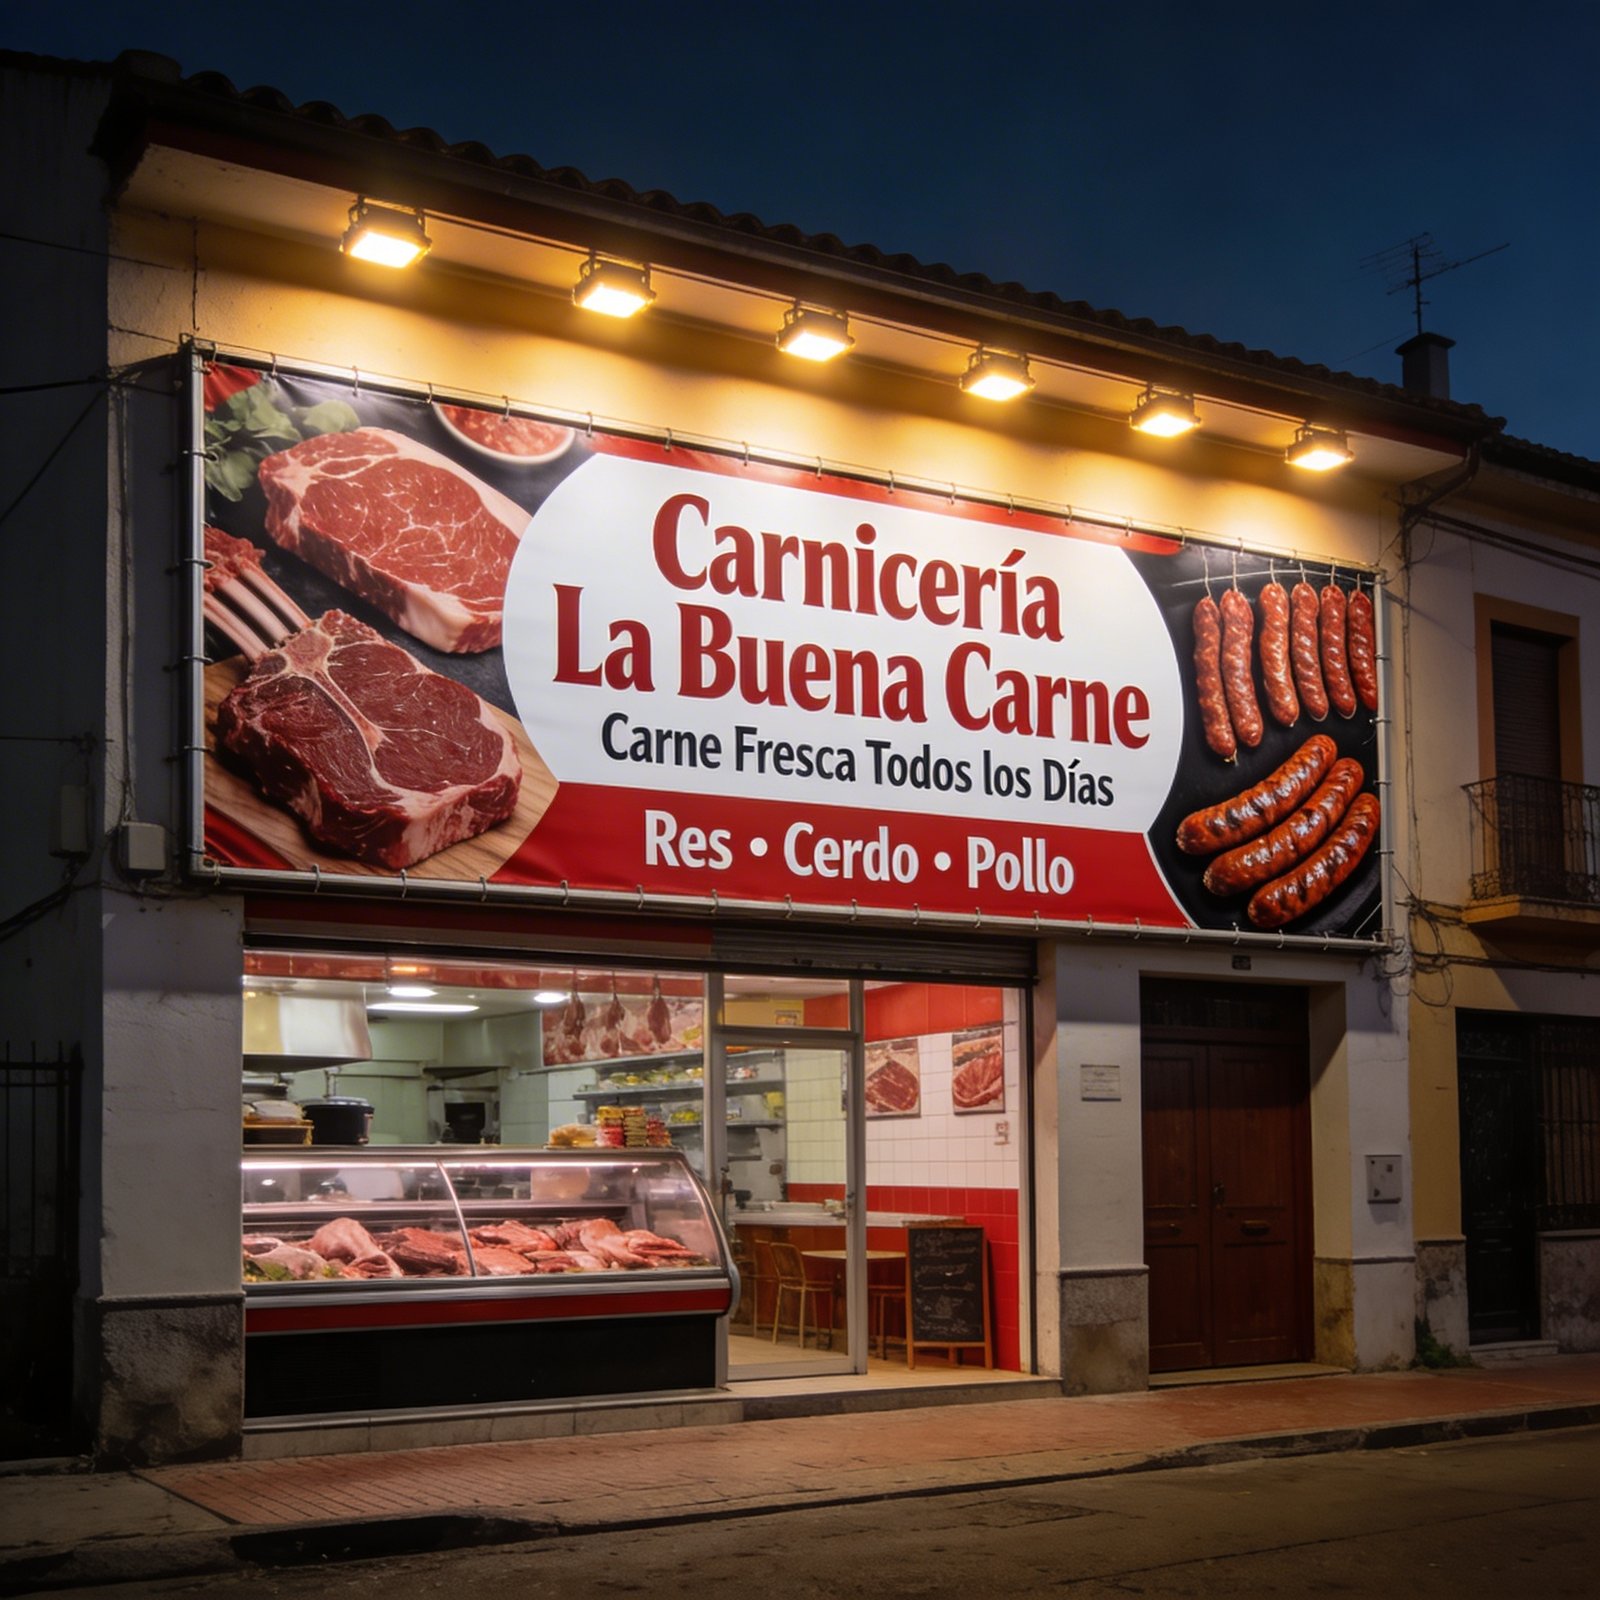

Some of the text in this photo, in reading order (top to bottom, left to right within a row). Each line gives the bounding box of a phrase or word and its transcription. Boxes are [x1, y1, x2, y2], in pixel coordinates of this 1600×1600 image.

[652, 493, 1063, 642] Carnicería
[553, 583, 1151, 749] La Buena Carne
[601, 711, 1114, 807] Carne Fresca Todos los Días
[644, 809, 733, 870] Res
[783, 821, 919, 884] Cerdo
[967, 836, 1075, 895] Pollo
